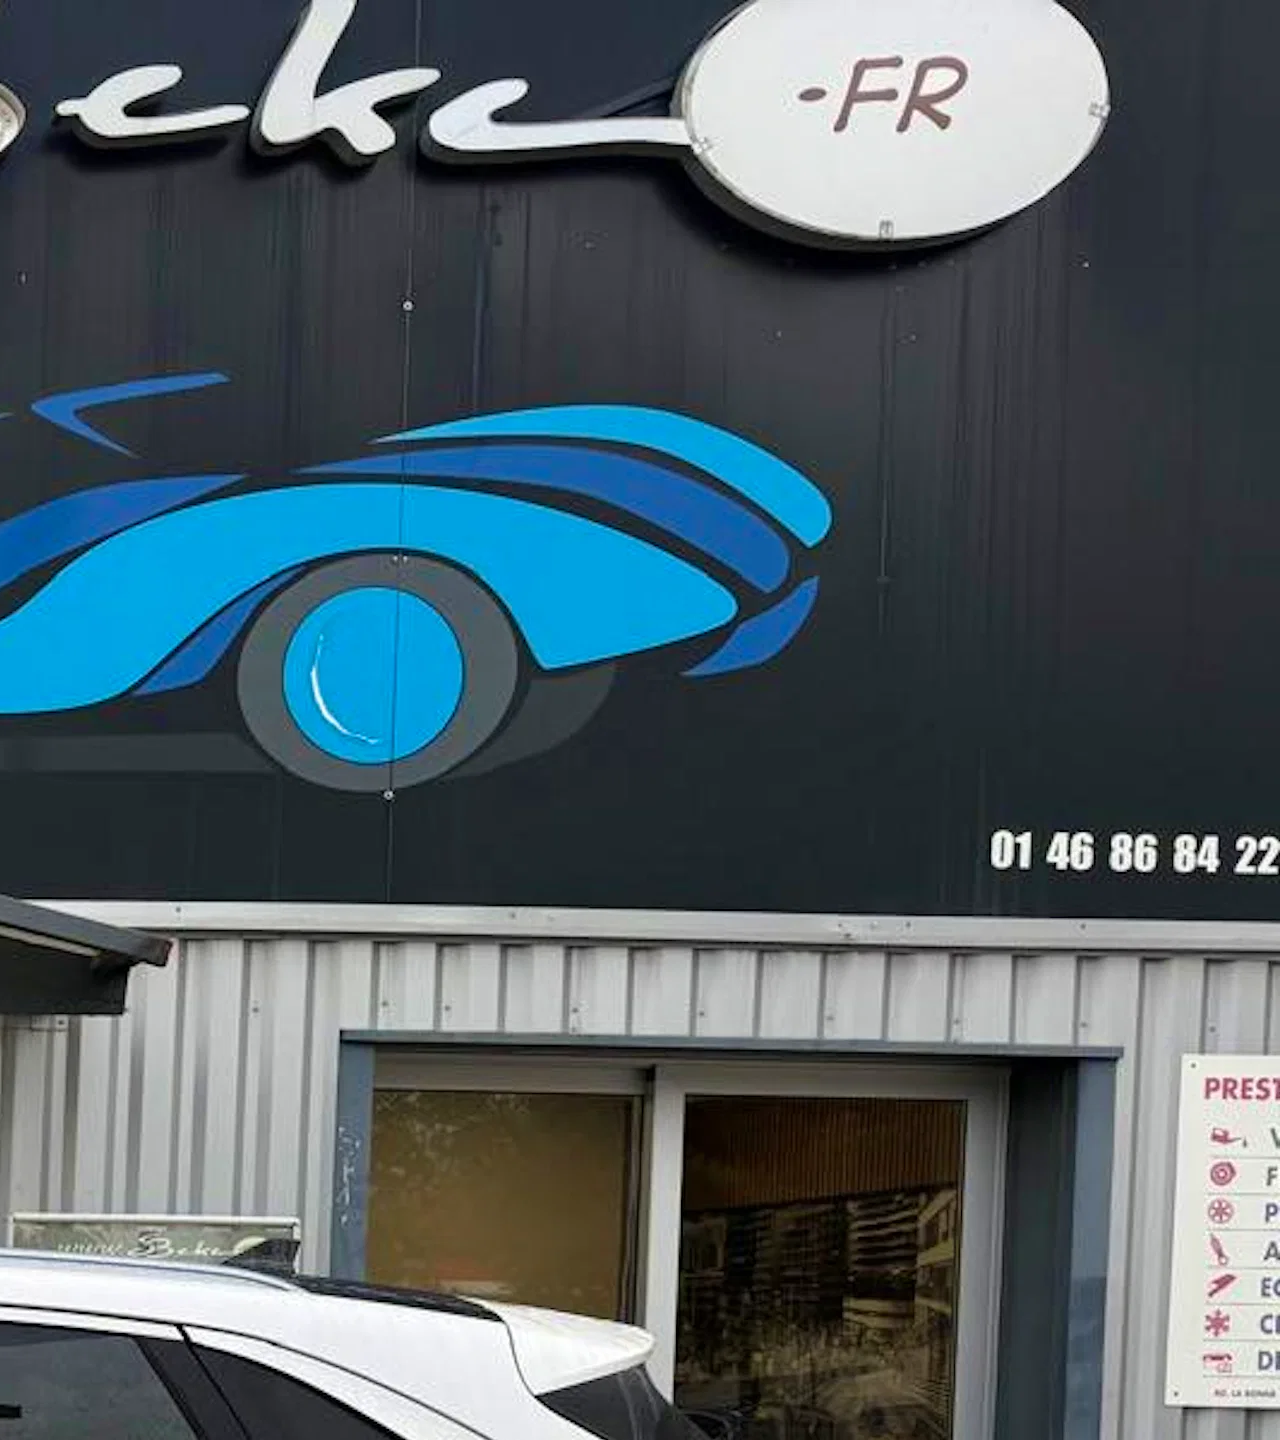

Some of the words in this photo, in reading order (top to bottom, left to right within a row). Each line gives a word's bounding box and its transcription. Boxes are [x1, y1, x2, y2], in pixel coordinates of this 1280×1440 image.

[990, 829, 1032, 871] 01
[1046, 831, 1094, 871] 46
[1109, 832, 1158, 873] 86
[1173, 833, 1220, 873] 84
[1235, 836, 1280, 875] 22
